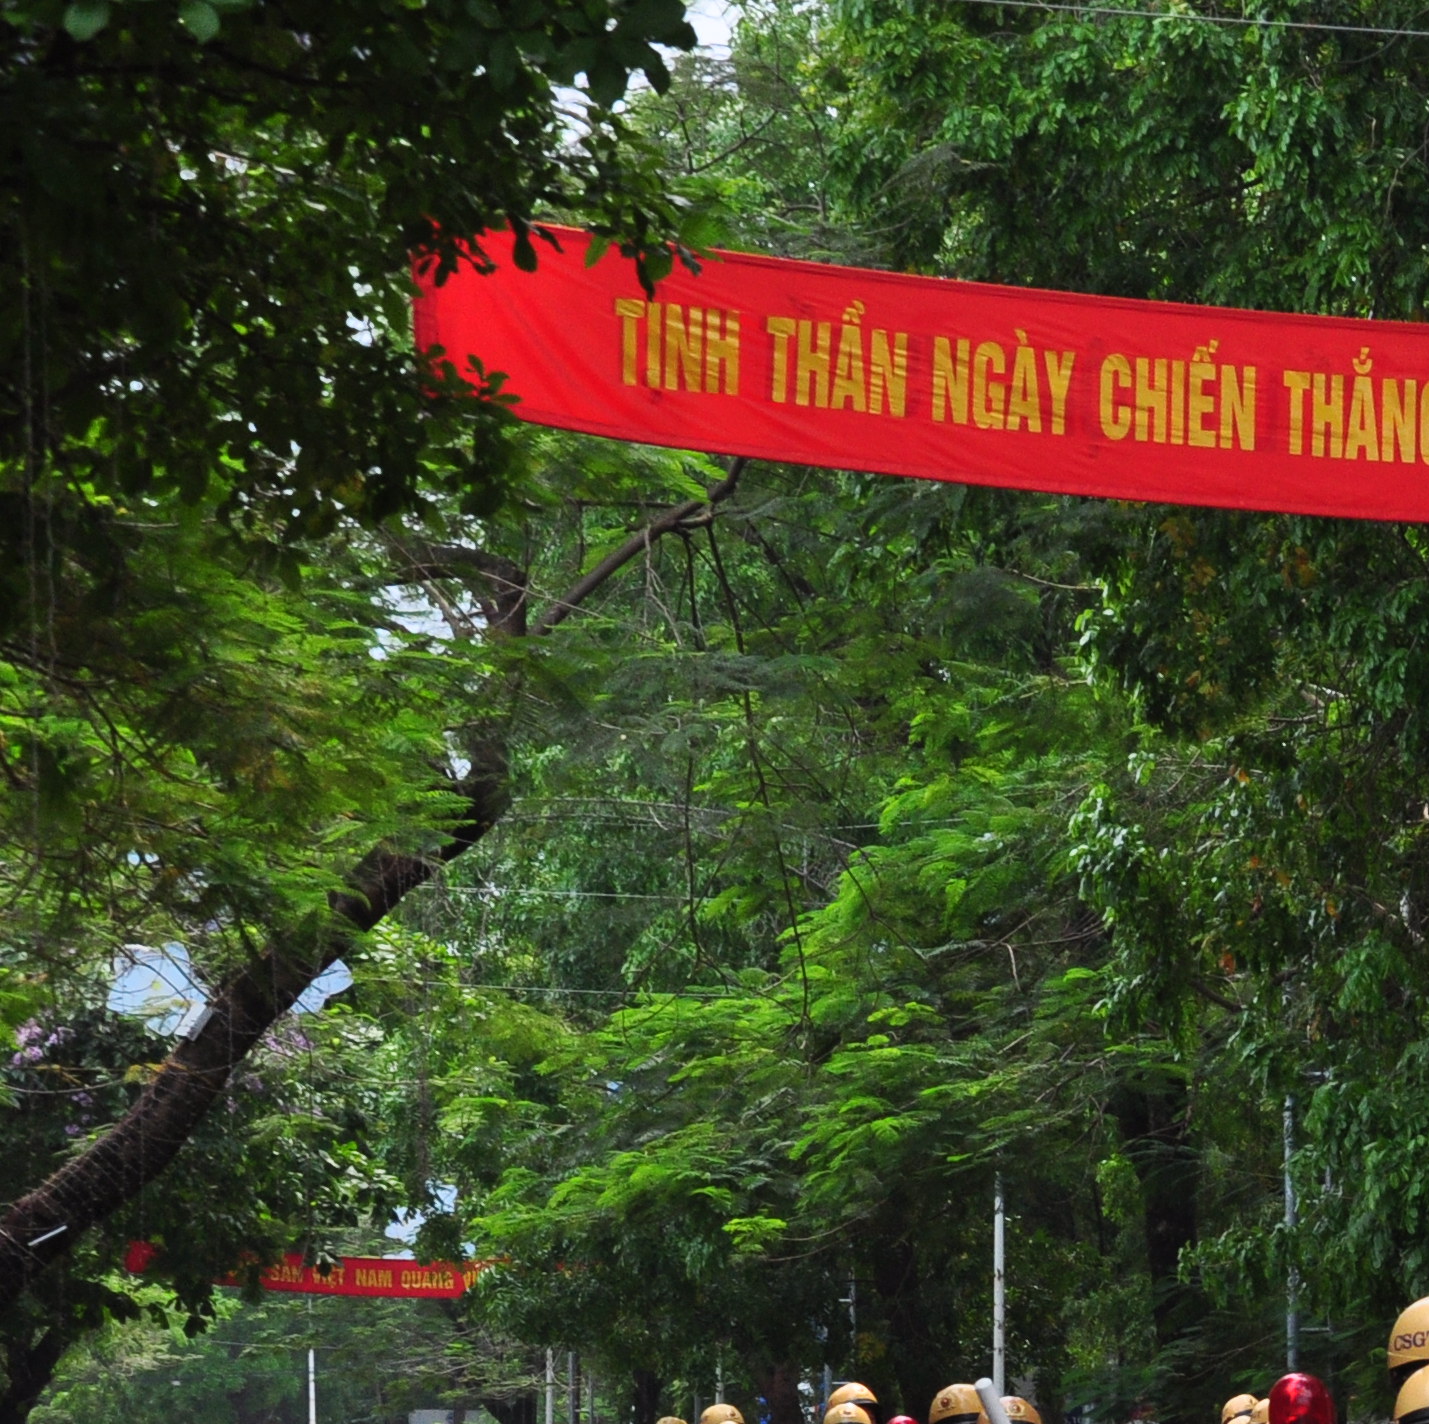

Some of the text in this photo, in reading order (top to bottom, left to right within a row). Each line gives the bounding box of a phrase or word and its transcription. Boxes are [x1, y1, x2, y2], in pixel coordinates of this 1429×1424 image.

[767, 298, 908, 417] THẦN
[933, 328, 1075, 436] NGÀY
[1099, 340, 1257, 449] CHIẾN
[356, 1267, 393, 1290] NAM
